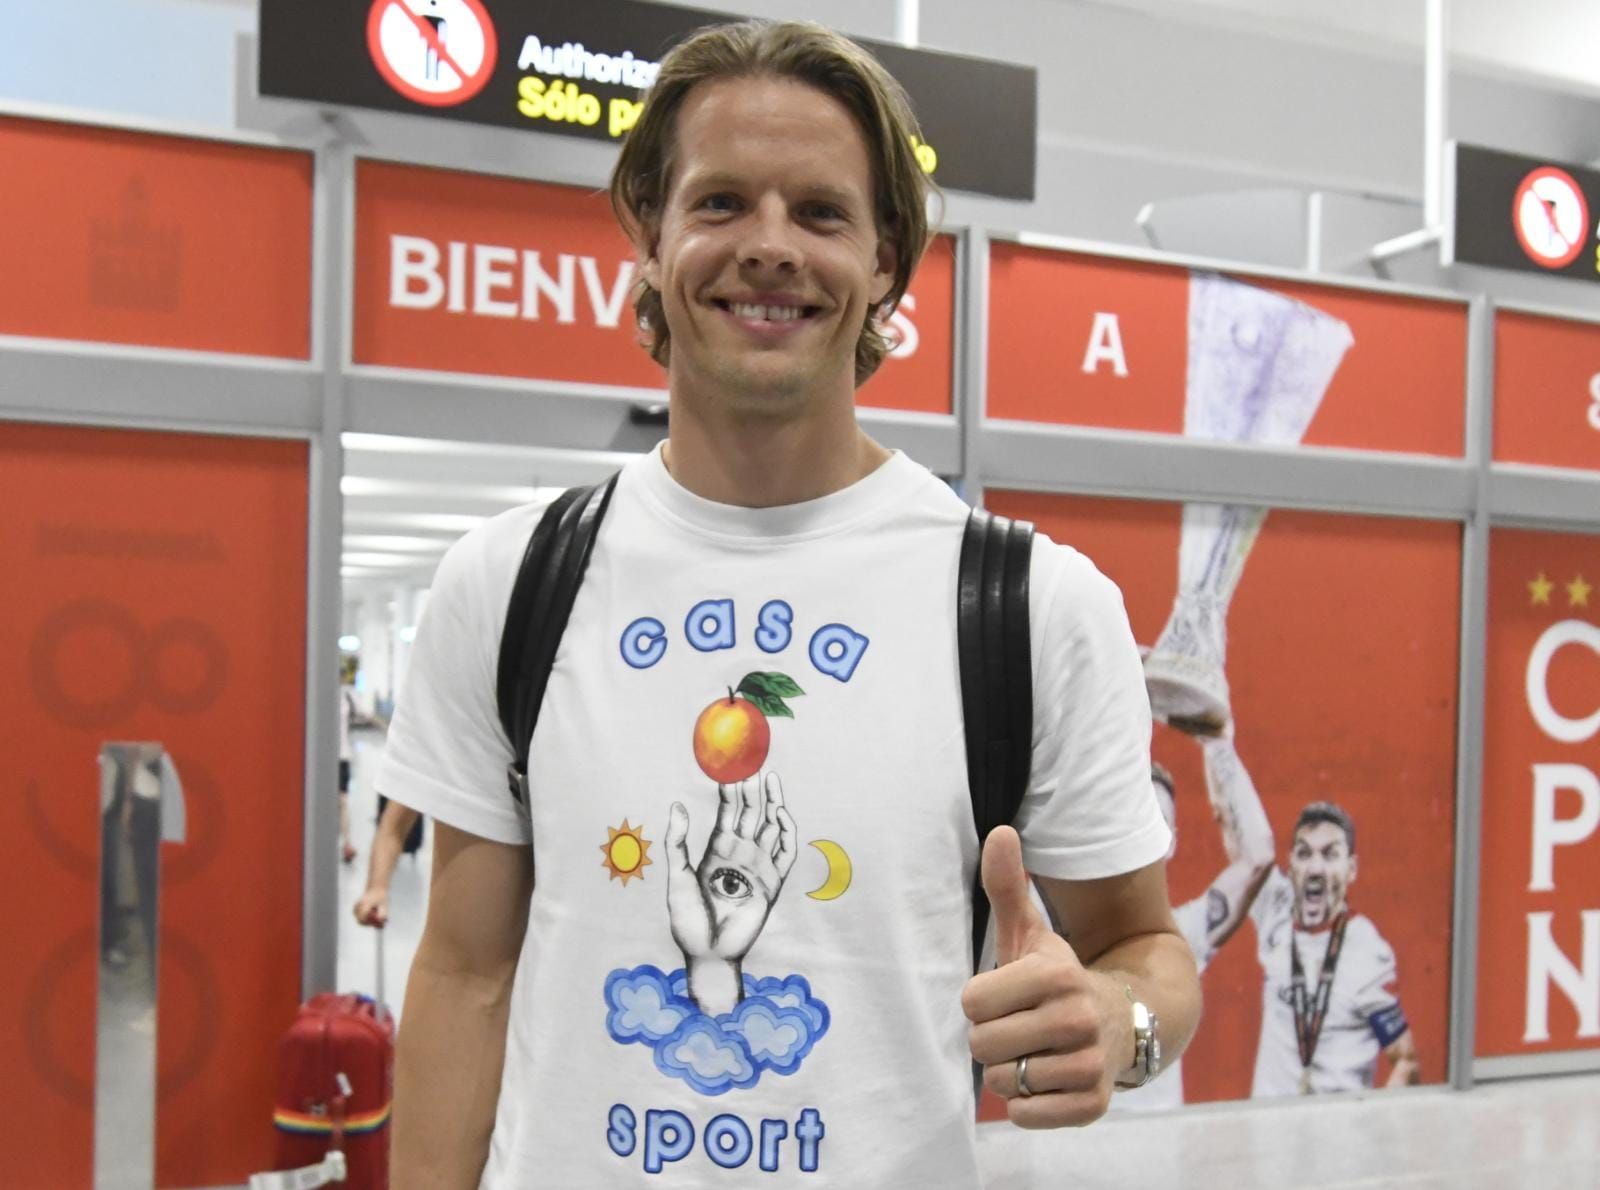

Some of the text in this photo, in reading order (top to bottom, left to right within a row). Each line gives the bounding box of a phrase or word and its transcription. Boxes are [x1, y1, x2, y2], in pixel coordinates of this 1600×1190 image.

[517, 75, 600, 125] Sólo
[1081, 311, 1129, 377] A
[620, 597, 870, 683] casa
[606, 1103, 825, 1174] sport
